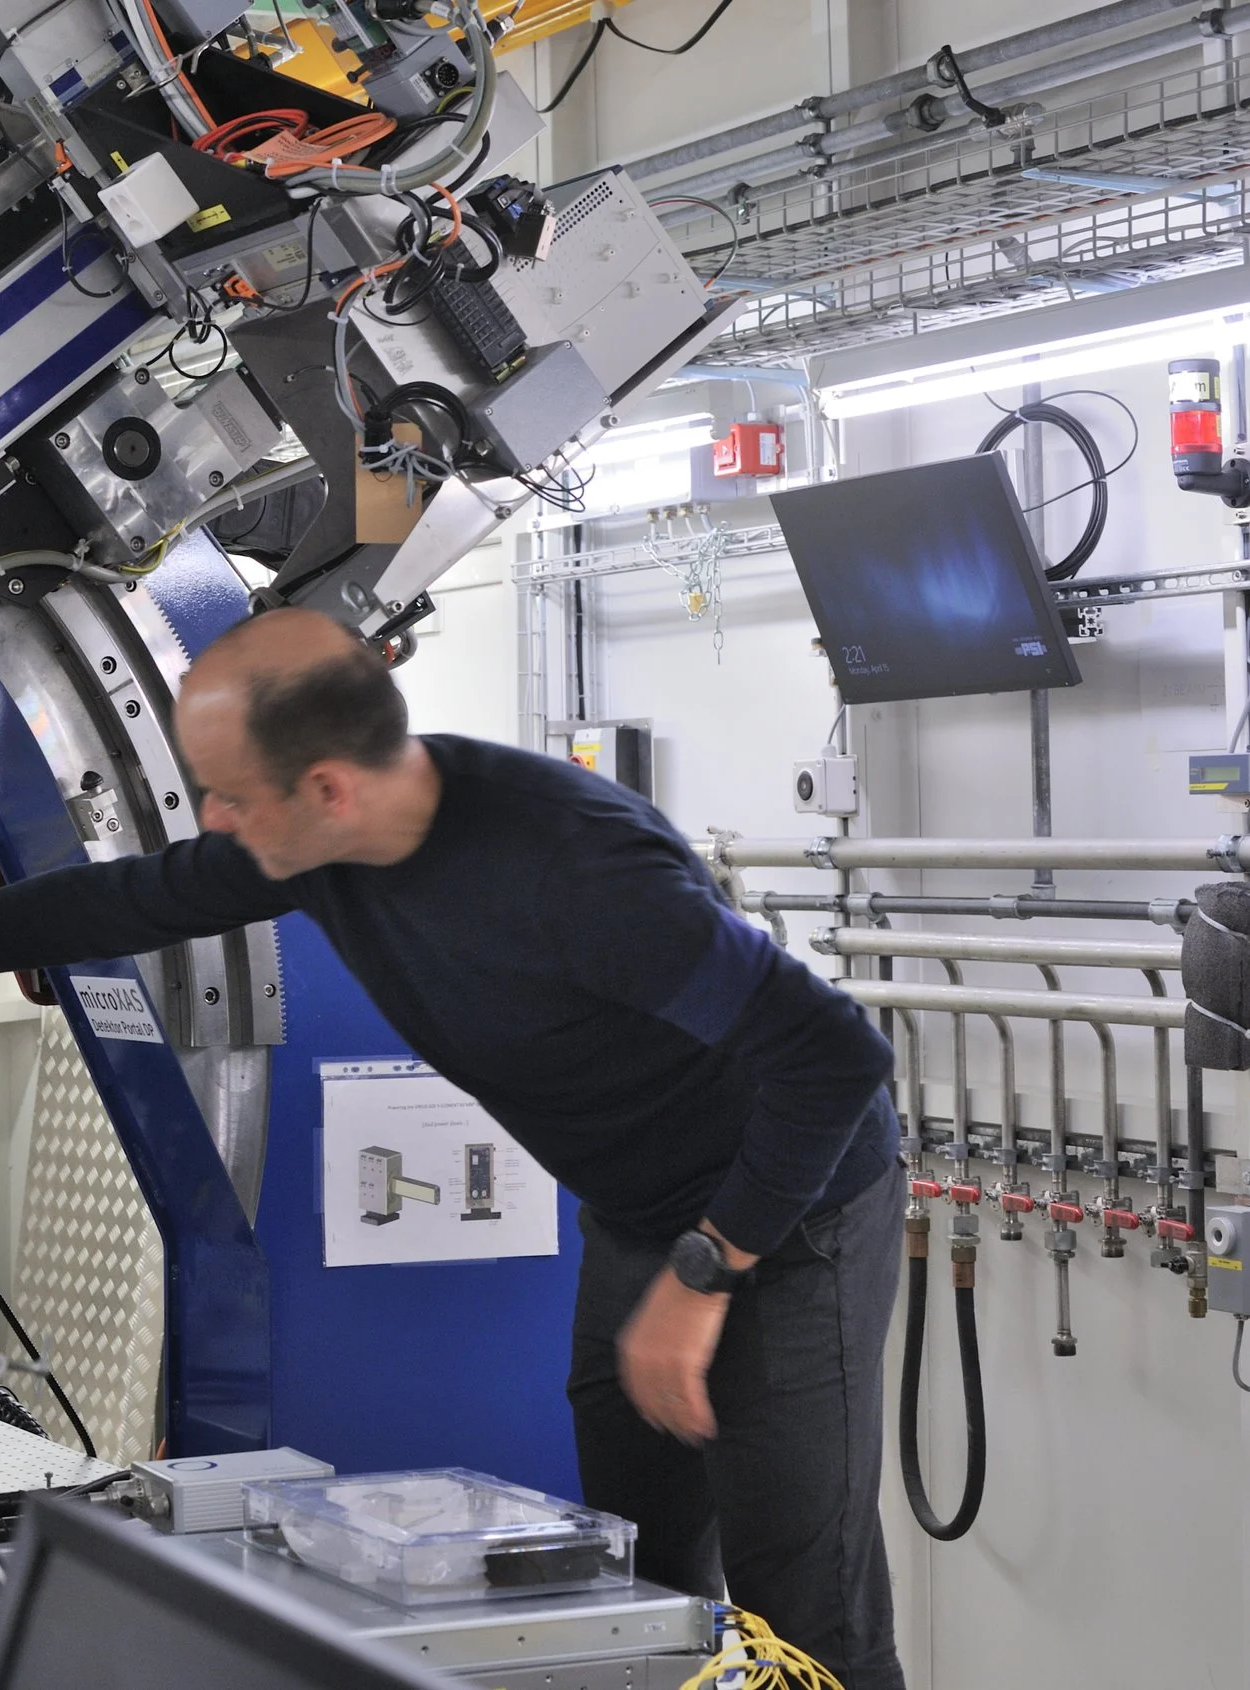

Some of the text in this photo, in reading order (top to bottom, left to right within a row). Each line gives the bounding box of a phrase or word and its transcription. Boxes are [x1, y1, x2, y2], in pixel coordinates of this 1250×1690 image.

[841, 645, 867, 664] 2:21
[79, 985, 144, 1013] microXAS
[91, 1018, 154, 1037] Detektor Portal DP
